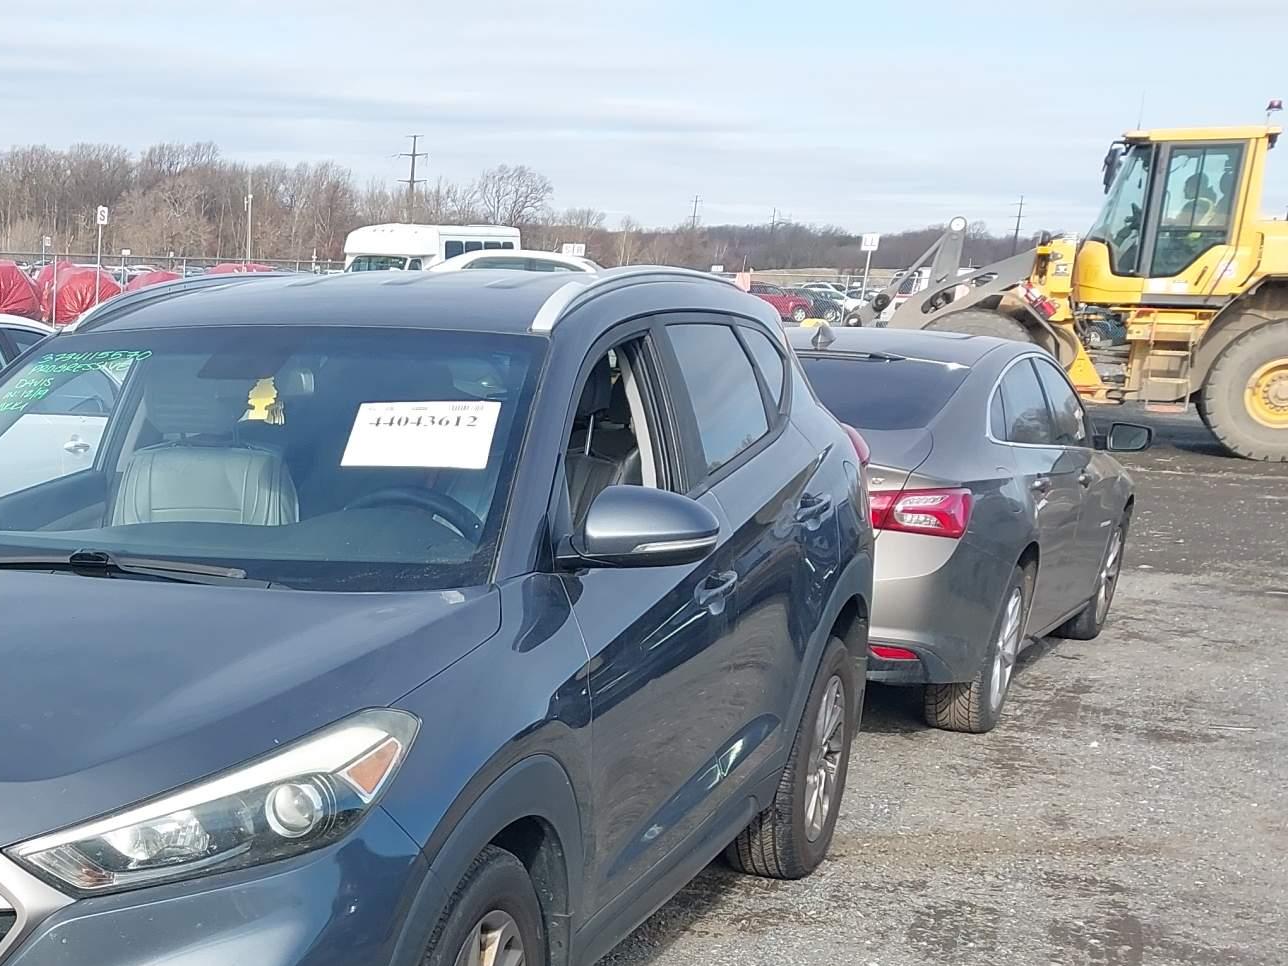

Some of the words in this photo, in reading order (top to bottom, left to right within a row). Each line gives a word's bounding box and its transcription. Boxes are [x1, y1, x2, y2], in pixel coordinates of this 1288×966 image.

[28, 361, 130, 374] PROGRESSIVE
[15, 377, 55, 389] DAVIS
[368, 415, 480, 428] 44043612
